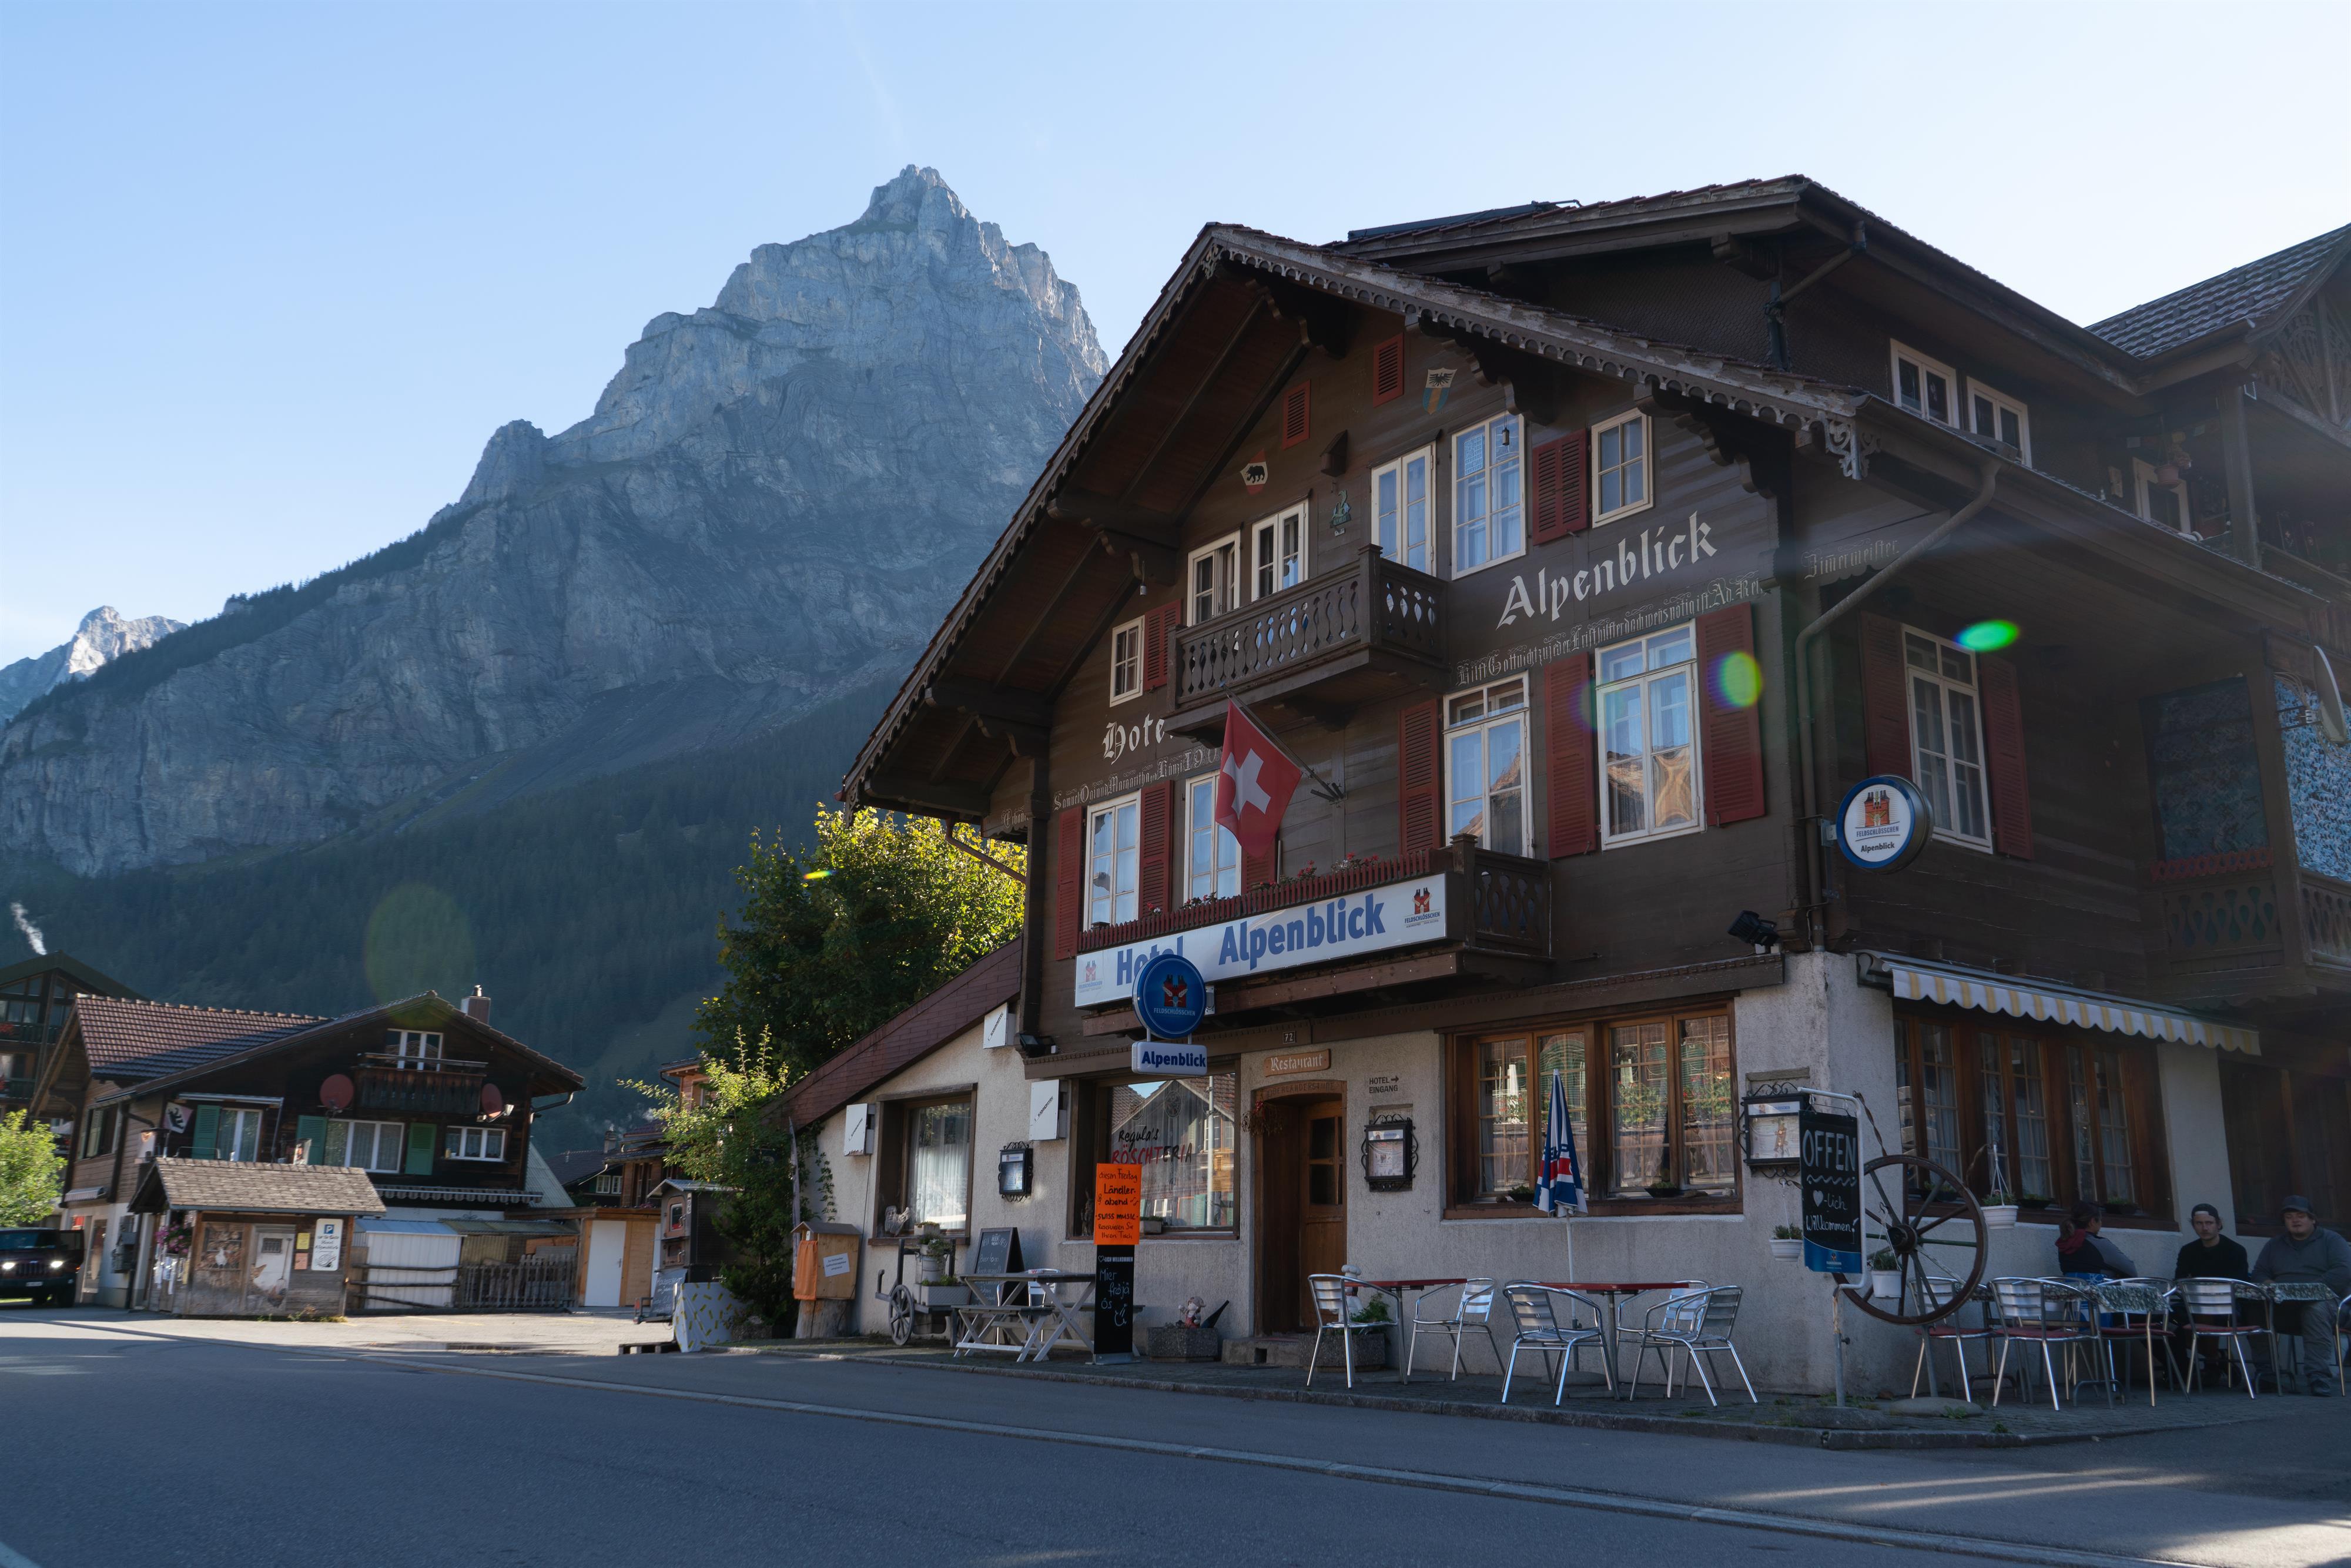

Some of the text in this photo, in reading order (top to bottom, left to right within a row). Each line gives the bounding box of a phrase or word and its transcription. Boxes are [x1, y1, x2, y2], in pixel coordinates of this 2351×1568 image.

[1495, 511, 1717, 630] Alpenblick
[1734, 578, 1763, 600] Rei
[1101, 713, 1174, 765] Hote
[1857, 826, 1899, 837] FELDSCHLÖSSCHEN
[1861, 841, 1895, 853] Alpenblick
[1405, 912, 1440, 923] FELDSCHLÖSSCHEN
[1218, 892, 1386, 970] Alpenblick
[1154, 1007, 1195, 1016] FELDSCHLÖSSCHEN
[1285, 1033, 1293, 1042] 72
[1141, 1051, 1206, 1068] Alpenblick
[1271, 1053, 1323, 1071] Restaurant
[1369, 1076, 1389, 1085] HOTEL
[1369, 1085, 1398, 1094] EINGANG
[1118, 1125, 1159, 1152] Regula's
[1111, 1143, 1193, 1165] RÖSCHTERIA
[1802, 1129, 1857, 1171] OFFEN
[1118, 1168, 1138, 1183] Freitag
[1104, 1197, 1128, 1205] abend
[1118, 1231, 1133, 1239] Tisch
